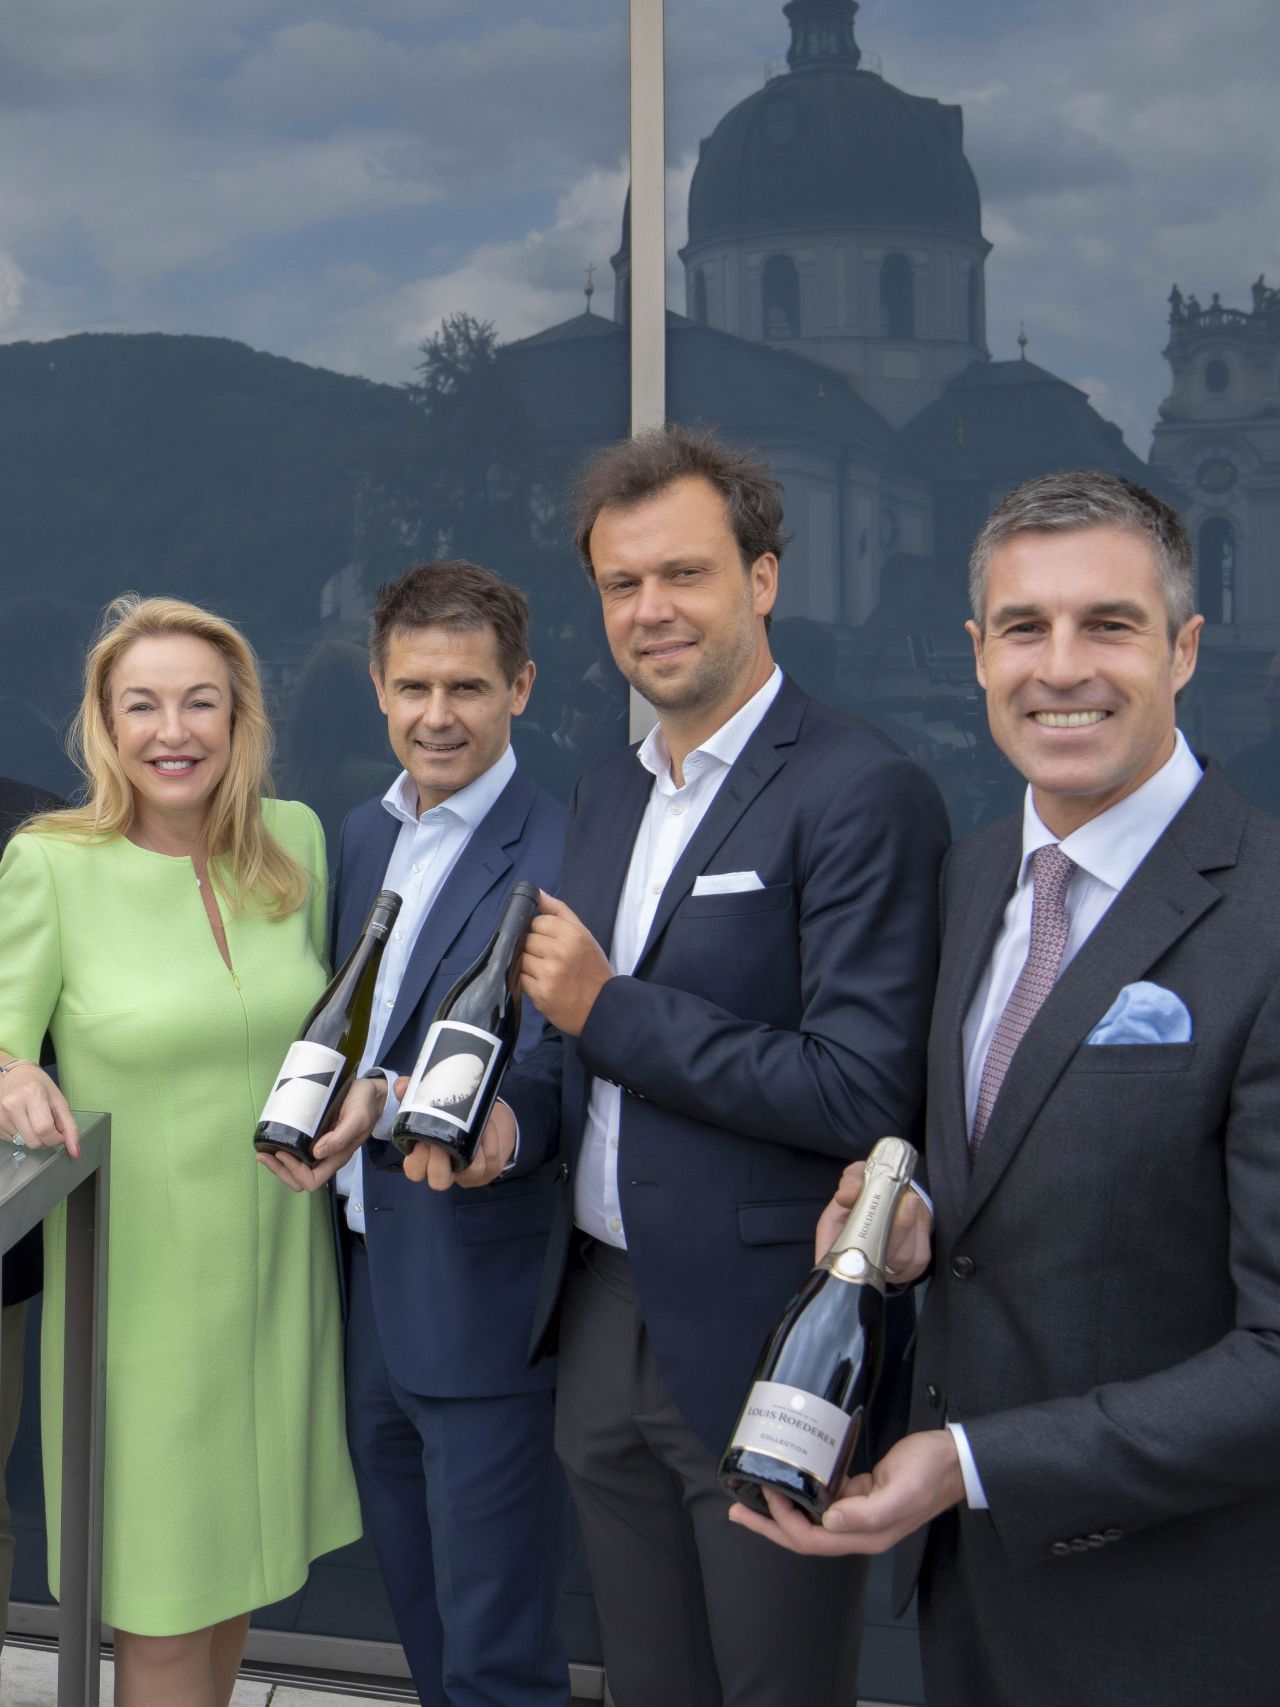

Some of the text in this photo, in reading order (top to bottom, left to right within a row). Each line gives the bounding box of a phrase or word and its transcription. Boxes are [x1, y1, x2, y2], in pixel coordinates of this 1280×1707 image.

[858, 1193, 881, 1240] ROEDERER
[747, 1406, 777, 1419] LOUIS
[778, 1411, 837, 1449] ROEDERER
[760, 1432, 808, 1455] COLLECTION
